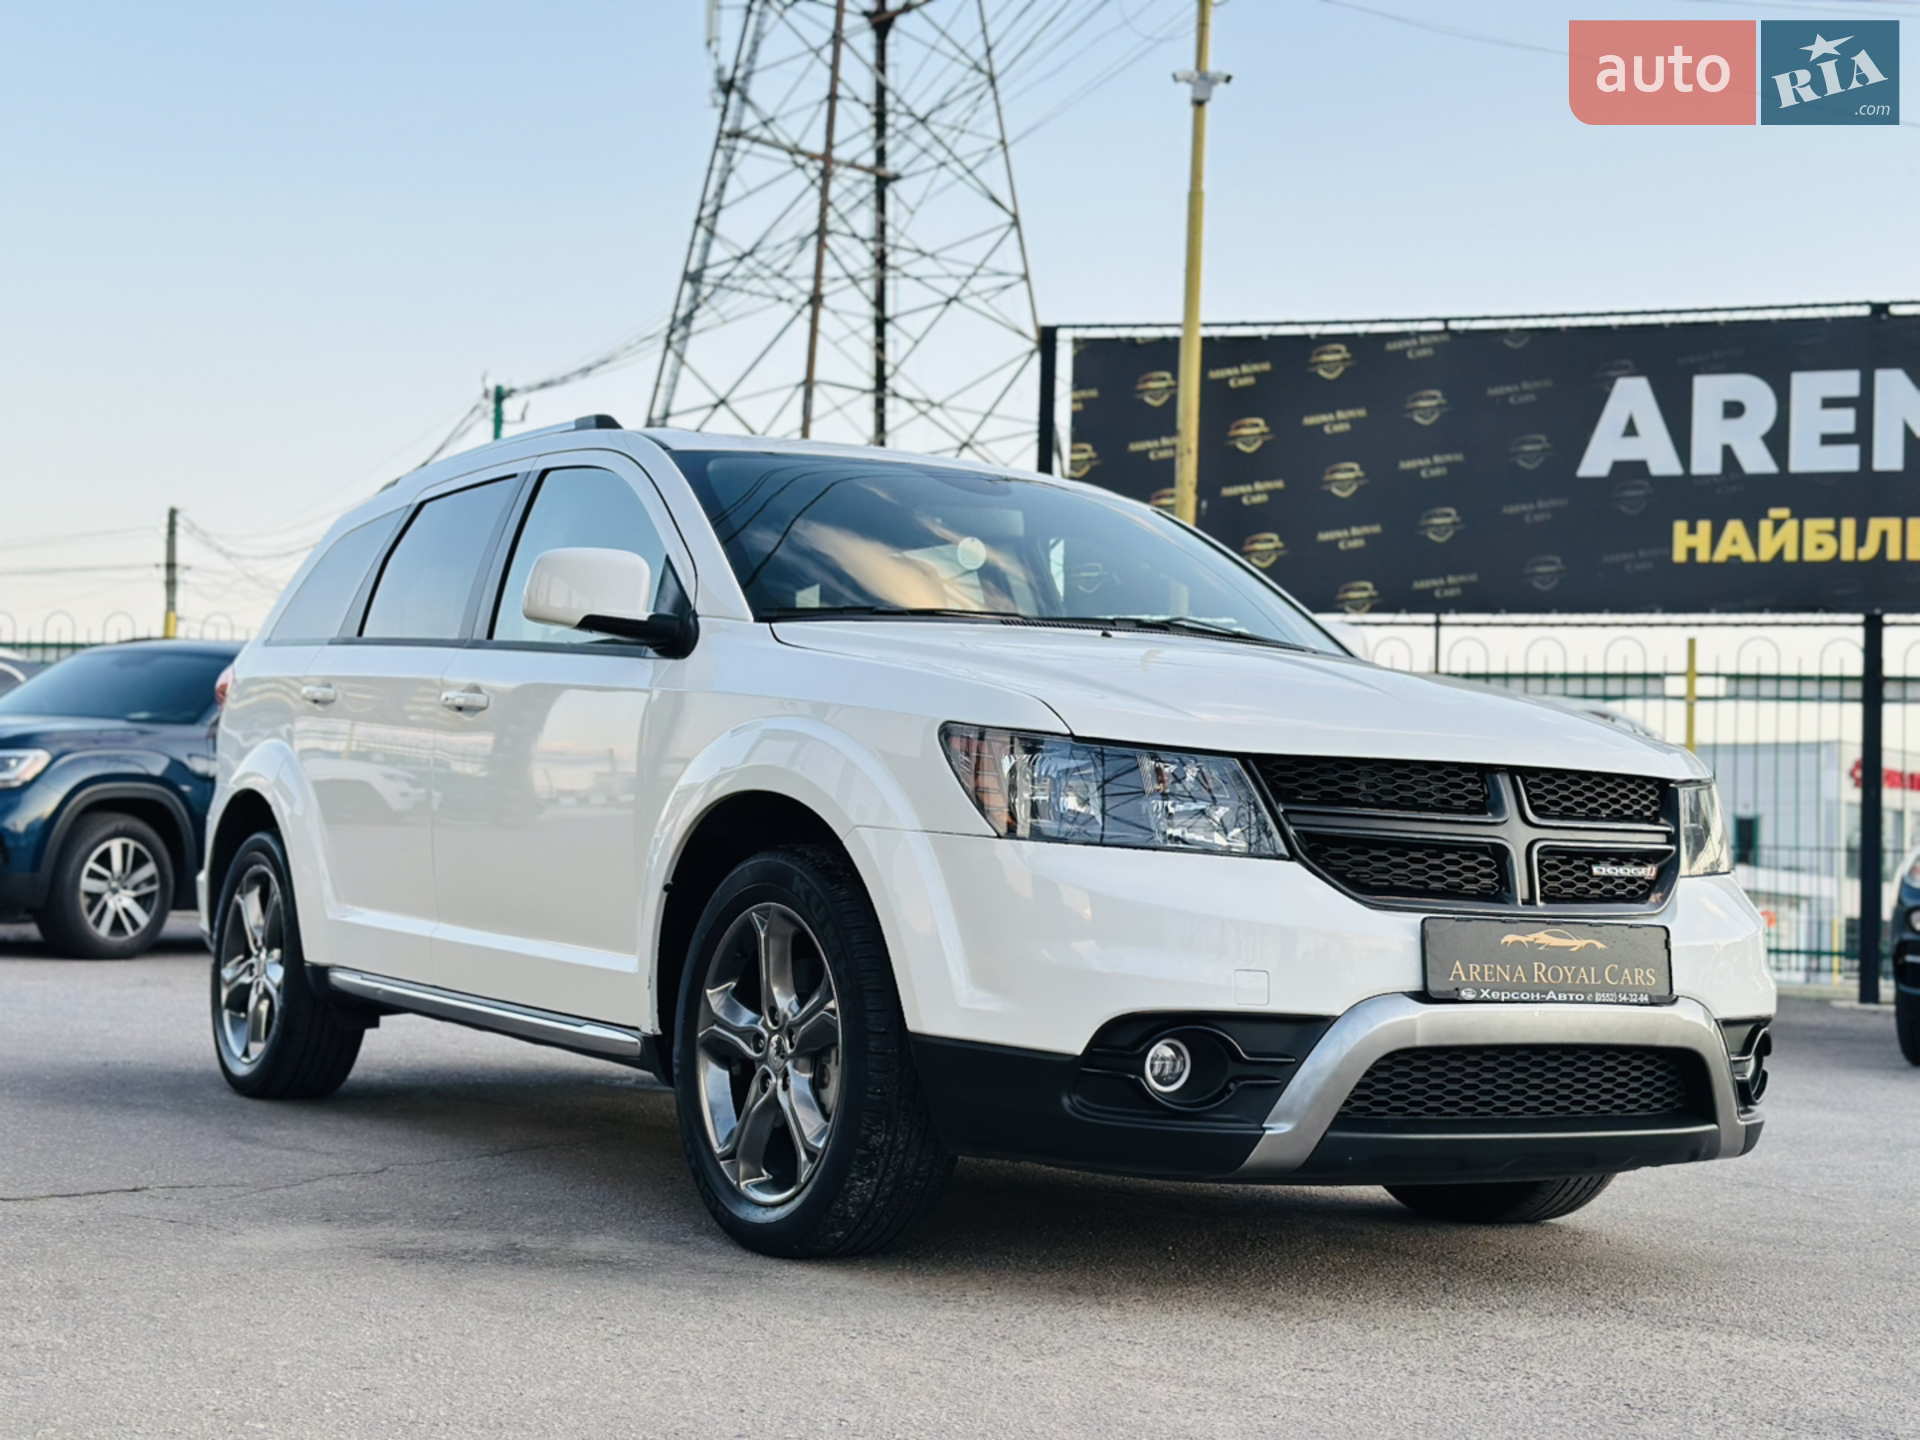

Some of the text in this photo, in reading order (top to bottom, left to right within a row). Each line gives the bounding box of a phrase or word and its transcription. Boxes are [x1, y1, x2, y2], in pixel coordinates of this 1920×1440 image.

[1449, 960, 1656, 986] ARENA ROYAL CARS
[1479, 988, 1585, 1003] Херсон-Авто
